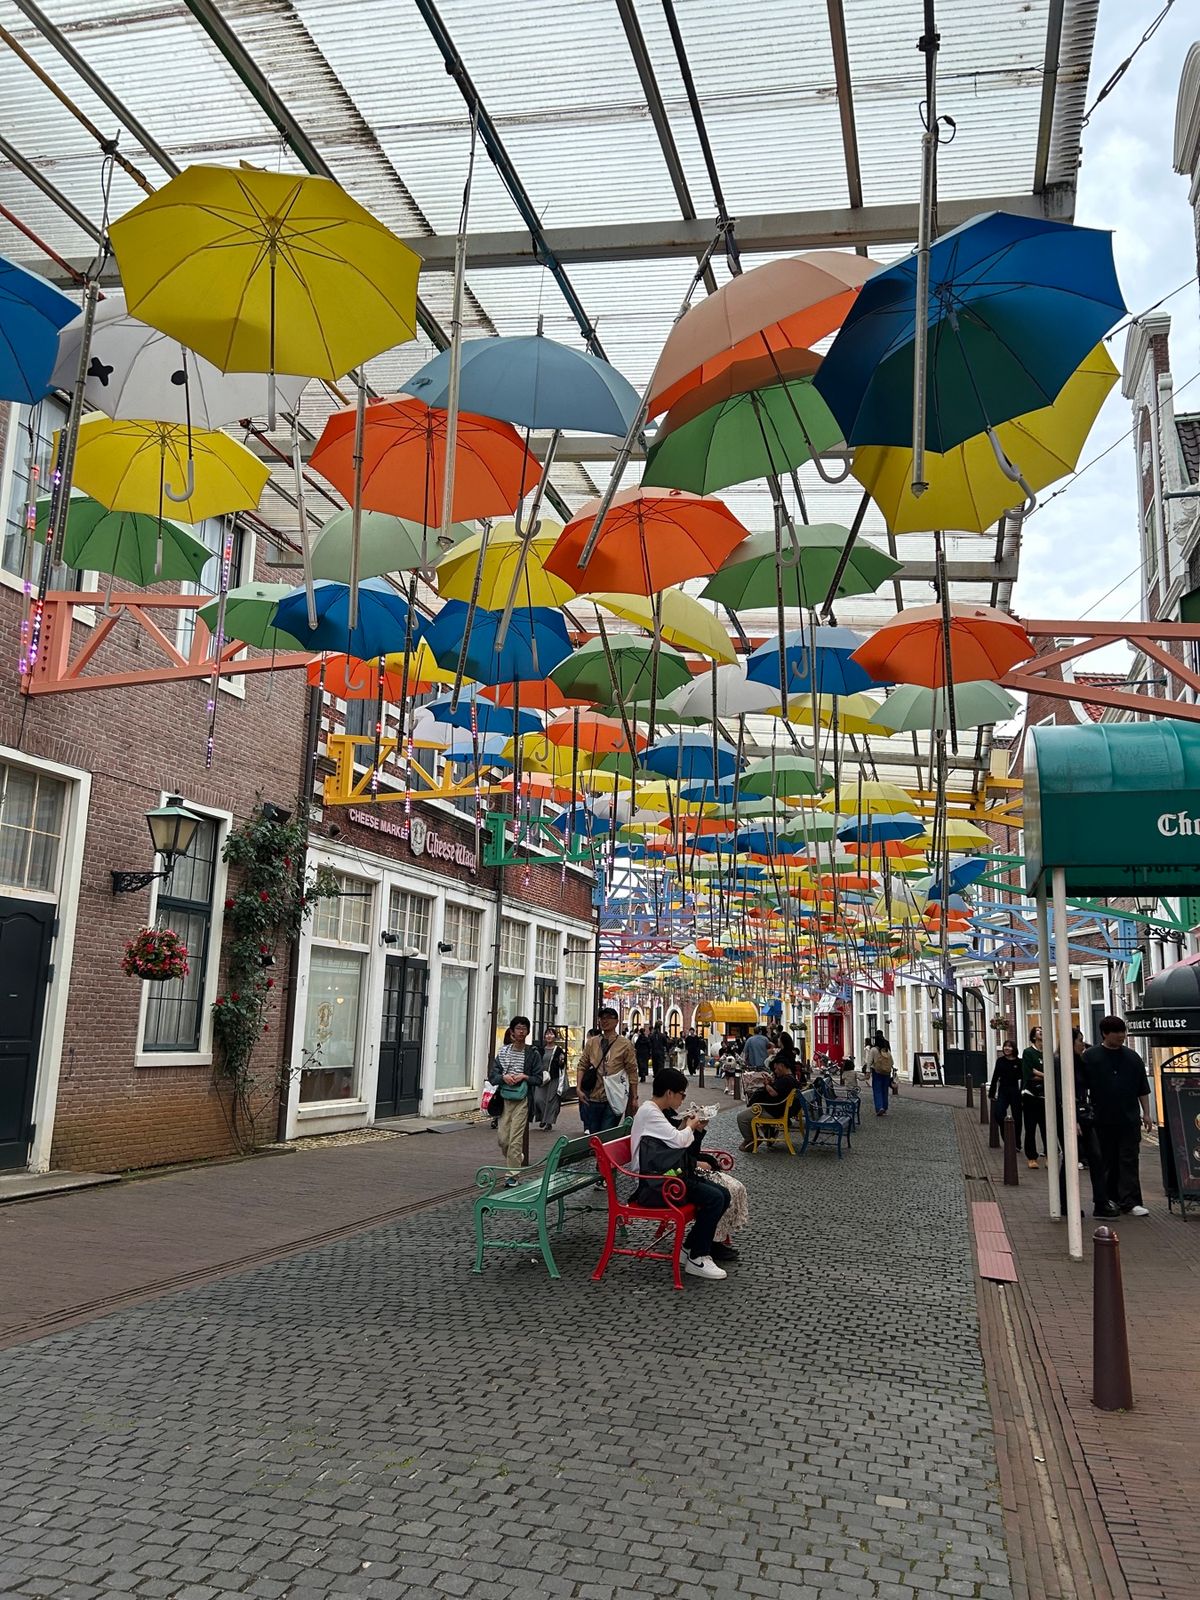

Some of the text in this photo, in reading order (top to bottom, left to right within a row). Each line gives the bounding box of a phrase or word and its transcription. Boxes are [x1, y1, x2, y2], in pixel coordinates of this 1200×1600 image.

[349, 808, 379, 829] CHEESE
[426, 831, 455, 861] Cheese
[1152, 1016, 1188, 1029] House
